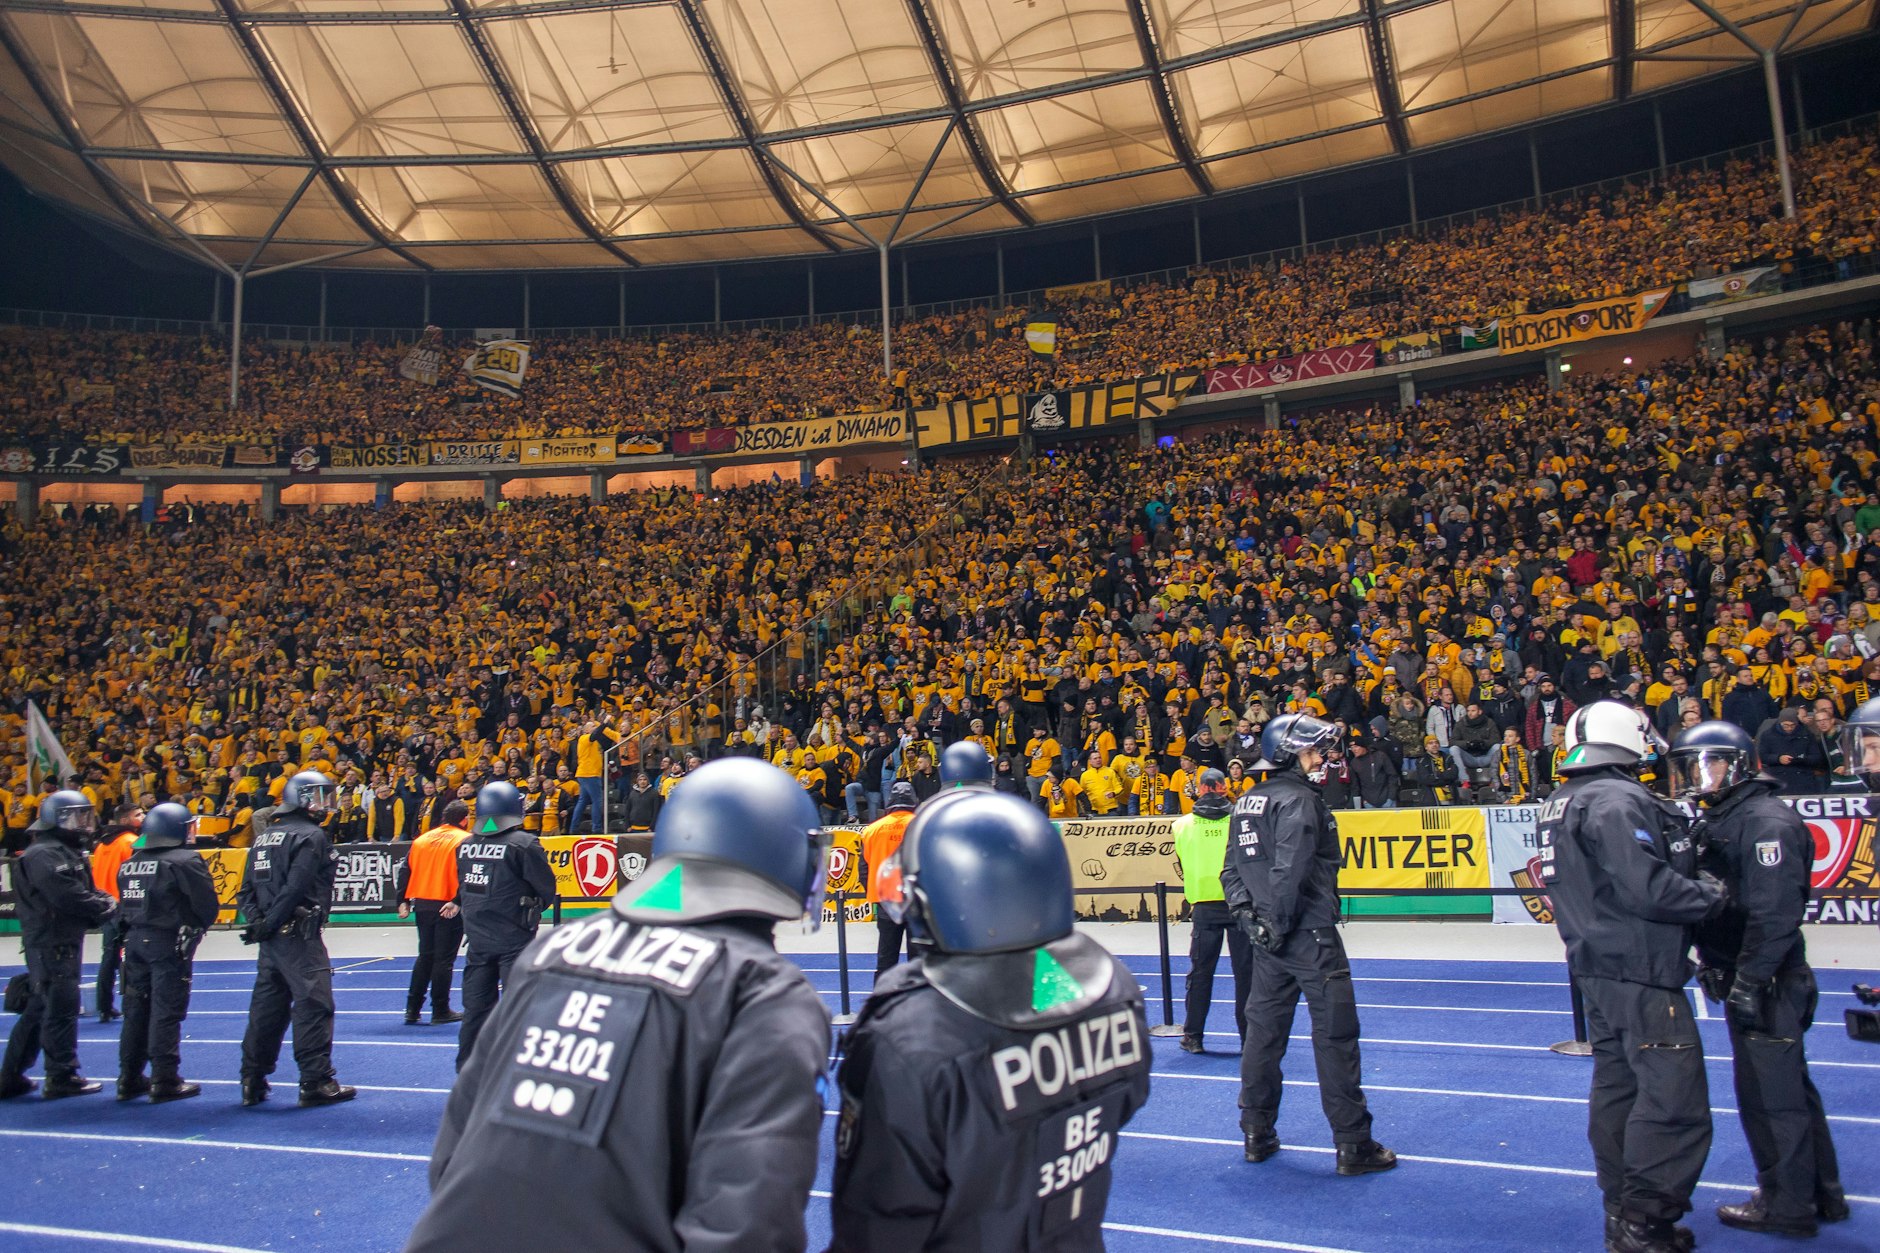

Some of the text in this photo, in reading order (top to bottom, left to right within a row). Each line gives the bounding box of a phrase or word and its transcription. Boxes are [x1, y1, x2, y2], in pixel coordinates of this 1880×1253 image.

[1206, 366, 1264, 393] RED
[735, 426, 808, 452] DRESDEN
[811, 426, 831, 445] ist
[837, 416, 902, 443] DYNAMO
[352, 445, 420, 467] NOSSEN
[542, 442, 598, 460] FIGHTERS
[1141, 772, 1149, 799] DYNAM
[253, 831, 287, 849] POLIZEI
[1065, 821, 1173, 839] Dynamohol
[1204, 829, 1223, 837] 5151
[257, 850, 267, 861] BE
[458, 843, 507, 860] POLIZEI
[118, 860, 159, 877] POLIZEI
[335, 854, 392, 876] SDEN
[472, 864, 485, 874] BE
[128, 879, 141, 889] BE
[464, 873, 490, 885] 33124
[827, 867, 852, 889] ESDEN
[122, 889, 146, 899] 33126
[332, 882, 381, 902] TTA
[533, 918, 718, 988] POLIZEI
[558, 990, 613, 1033] BE
[515, 1026, 617, 1082] 33101
[992, 1008, 1141, 1111] POLIZEI
[1064, 1105, 1104, 1151] BE
[1036, 1131, 1111, 1198] 33000
